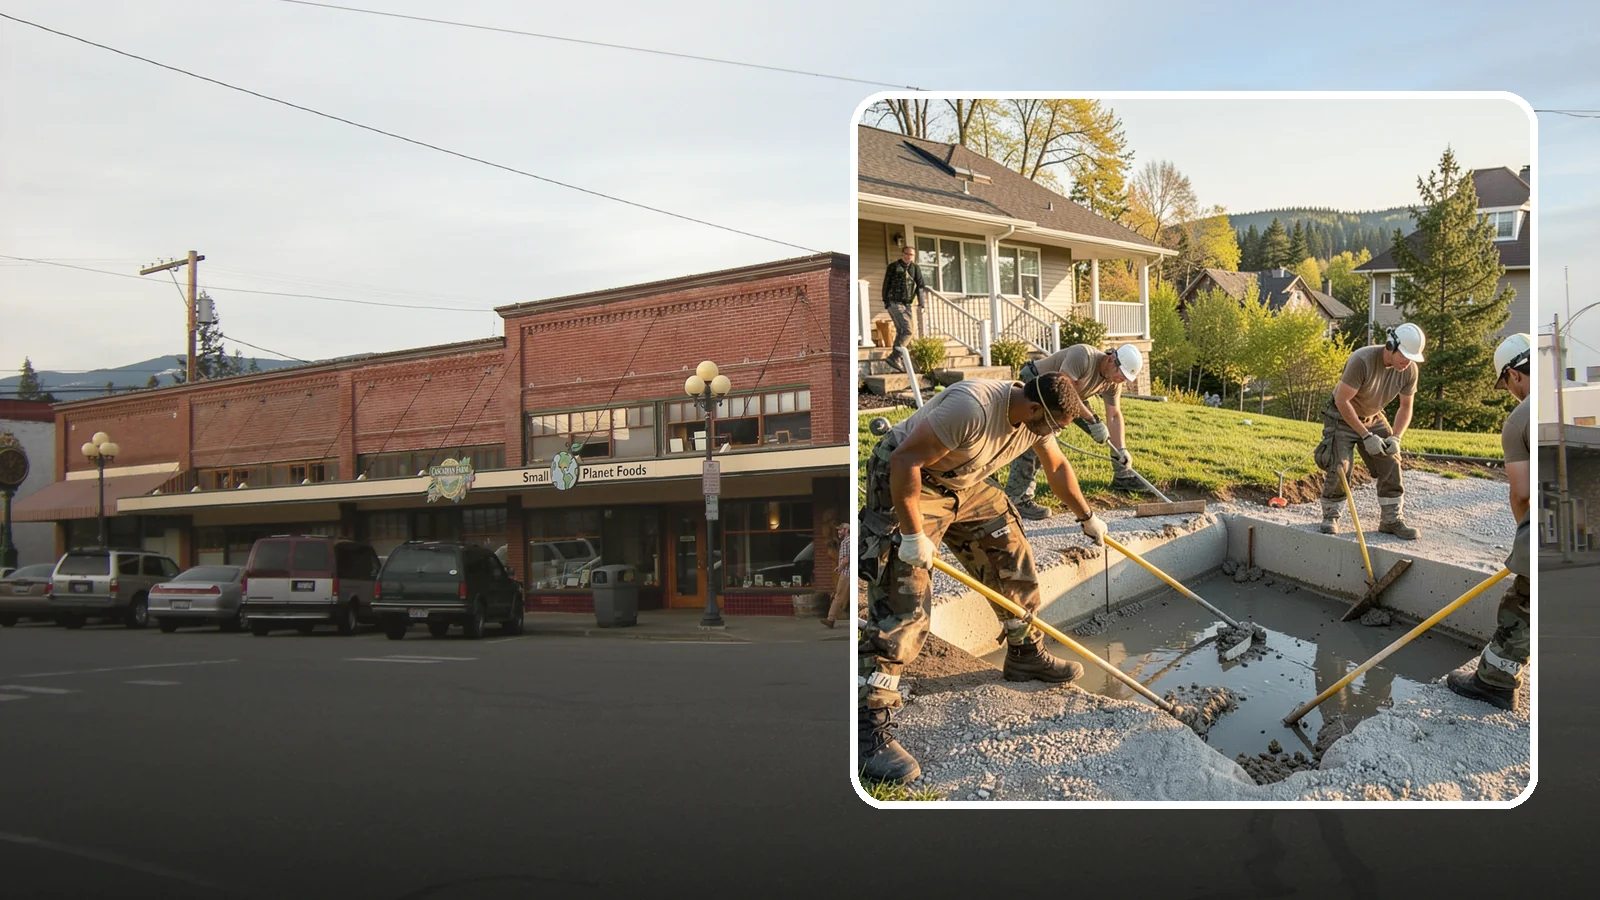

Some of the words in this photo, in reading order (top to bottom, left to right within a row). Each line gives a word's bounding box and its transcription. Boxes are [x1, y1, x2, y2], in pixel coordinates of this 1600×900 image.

[523, 470, 549, 483] Small
[583, 467, 614, 479] Planet
[617, 464, 647, 477] Foods
